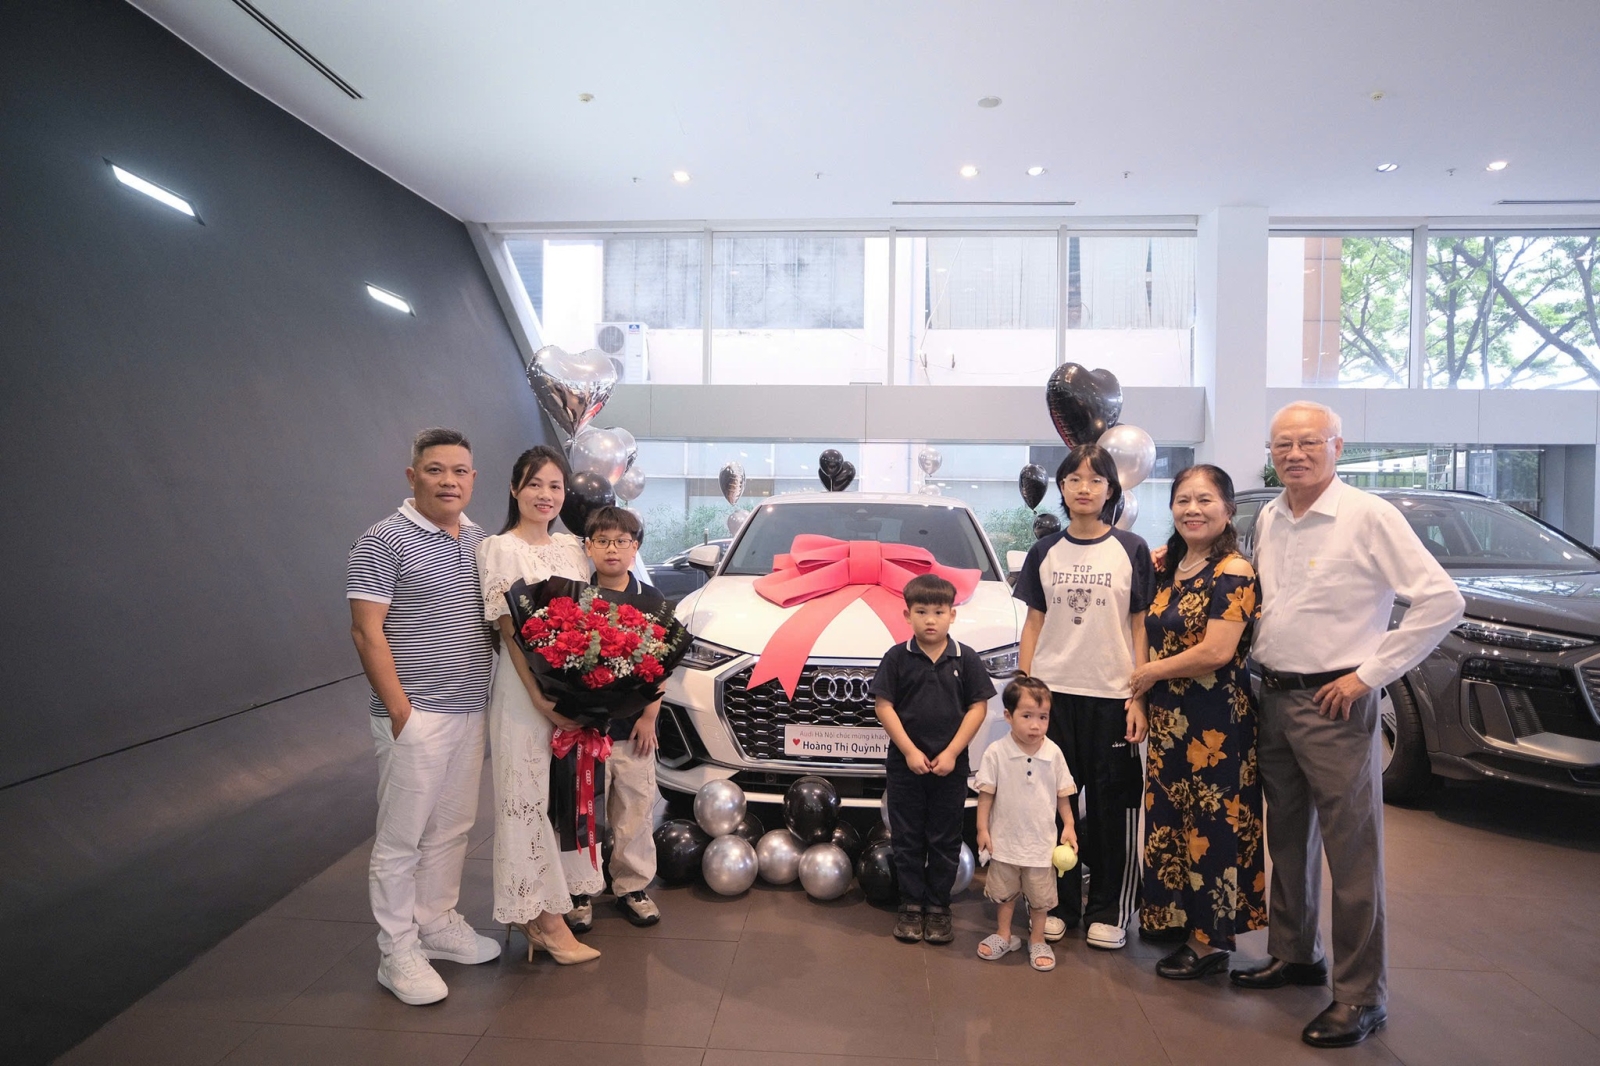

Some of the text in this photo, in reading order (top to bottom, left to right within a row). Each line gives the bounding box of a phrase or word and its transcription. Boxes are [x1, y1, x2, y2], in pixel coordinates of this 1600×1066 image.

[1073, 565, 1092, 573] TOP
[1052, 571, 1112, 588] DEFENDER
[1096, 598, 1105, 606] 84
[852, 732, 869, 740] mừng
[803, 741, 832, 753] Hoàng
[835, 742, 849, 754] Thị
[851, 743, 881, 754] Quỳnh
